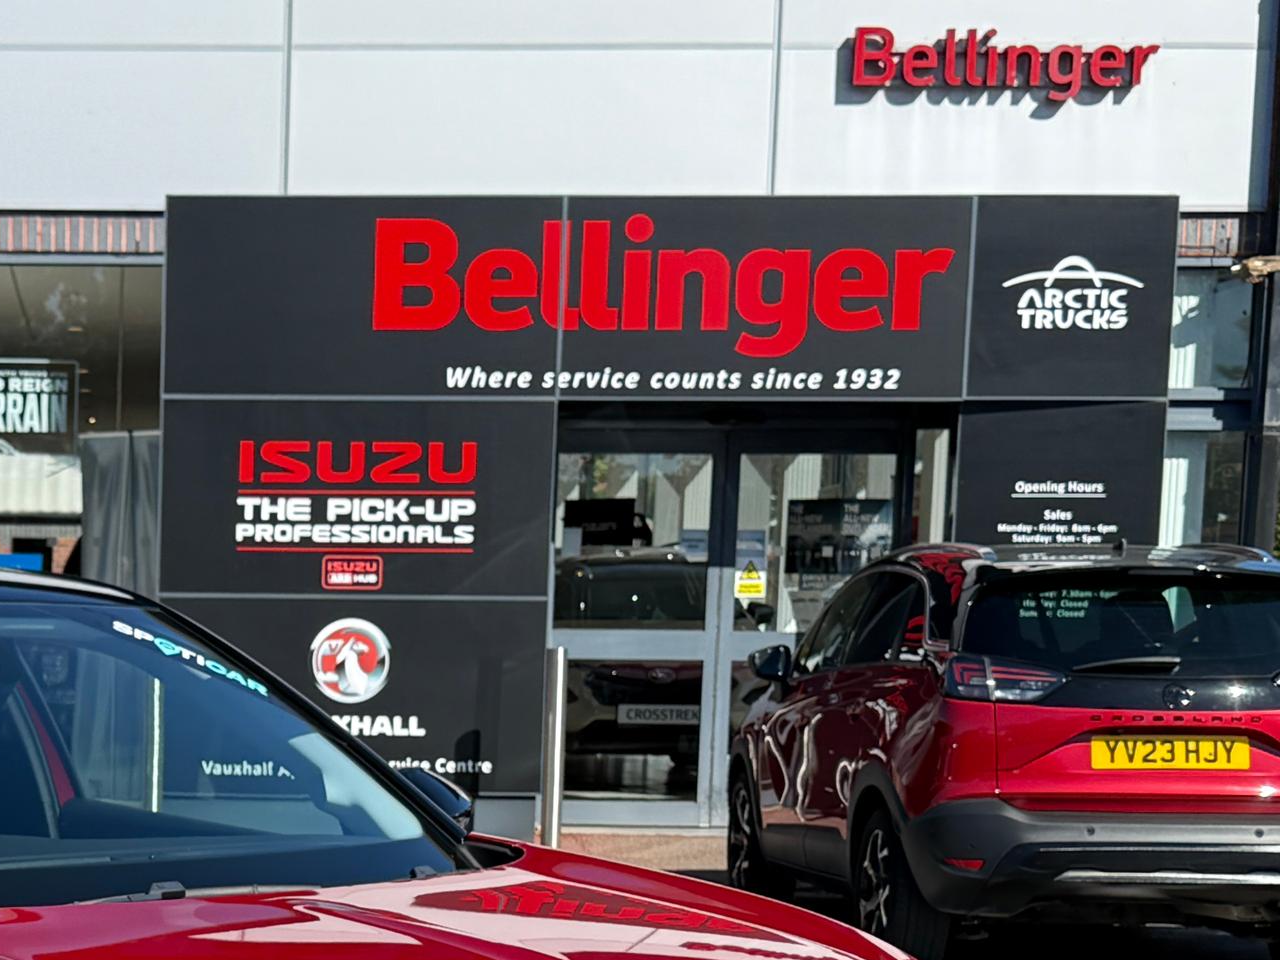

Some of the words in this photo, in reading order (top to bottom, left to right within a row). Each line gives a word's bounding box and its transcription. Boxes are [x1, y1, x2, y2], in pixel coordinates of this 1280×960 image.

[852, 27, 1160, 101] Bellinger
[372, 213, 955, 357] Bellinger
[1017, 288, 1128, 309] ARCTIC
[1016, 308, 1128, 330] TRUCKS
[7, 377, 68, 392] REIGN
[445, 366, 532, 389] Where
[541, 368, 639, 390] service
[649, 367, 741, 390] counts
[751, 367, 823, 390] since
[833, 368, 901, 390] 1932
[239, 440, 477, 483] ISUZU
[1015, 481, 1066, 494] Opening
[1068, 481, 1105, 492] Hours
[236, 497, 312, 521] THE
[326, 498, 476, 522] PICK-UP
[1043, 509, 1073, 520] Sales
[235, 523, 475, 544] PROFESSIONALS
[997, 523, 1033, 533] Monday
[1011, 533, 1052, 544] Saturday:
[326, 561, 378, 572] ISUZU
[1104, 740, 1175, 763] YV23
[1184, 740, 1236, 764] HJY
[201, 760, 274, 776] Vauxhall
[434, 757, 493, 774] Centre
